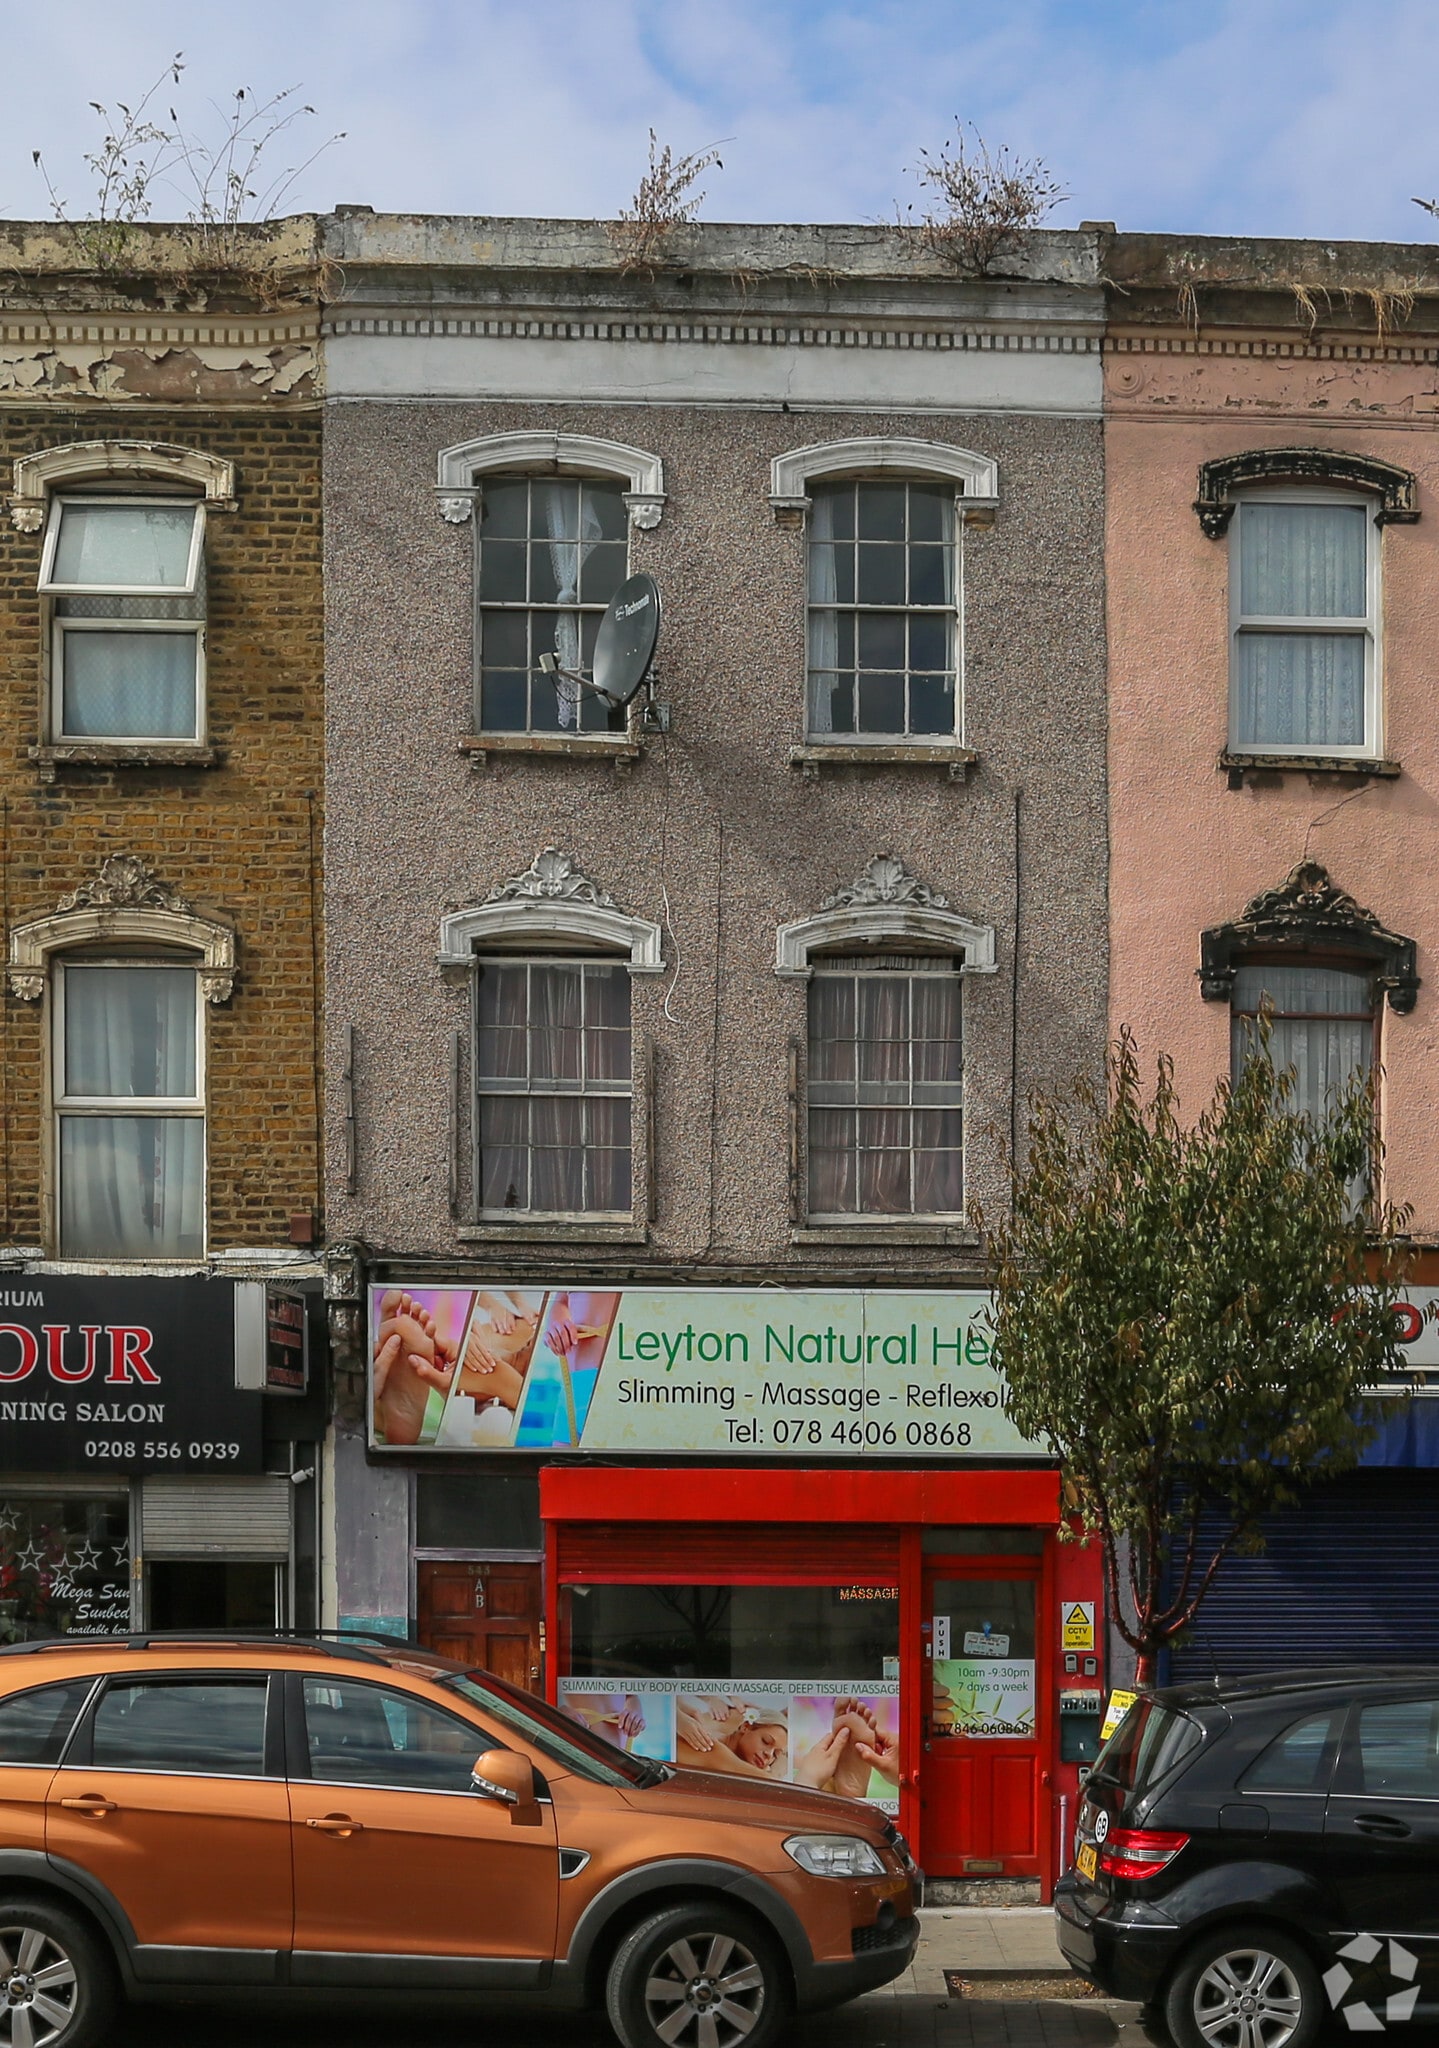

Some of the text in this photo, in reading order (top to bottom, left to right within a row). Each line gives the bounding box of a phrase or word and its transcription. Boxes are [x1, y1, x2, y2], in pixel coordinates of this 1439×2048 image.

[0, 1291, 44, 1306] IUM
[0, 1323, 161, 1384] OUR
[618, 1322, 1001, 1371] Leyton Natural He
[618, 1378, 735, 1410] Slimming
[761, 1382, 880, 1411] Massage
[907, 1383, 1014, 1408] Reflexol
[0, 1402, 165, 1423] NING SALON
[724, 1418, 972, 1446] Tel: 078 4606 0868
[84, 1441, 240, 1459] 0208 556 0939
[49, 1582, 95, 1603] Mega
[840, 1587, 899, 1600] MASSAGE
[66, 1624, 108, 1634] available
[958, 1668, 985, 1677] 10am
[562, 1681, 899, 1694] SLIMMING, FULLY BODY RELAXING MASSAGE, DEEP TISSUE MASSAGE
[958, 1682, 964, 1691] 7
[967, 1682, 990, 1693] days
[1002, 1682, 1028, 1691] week
